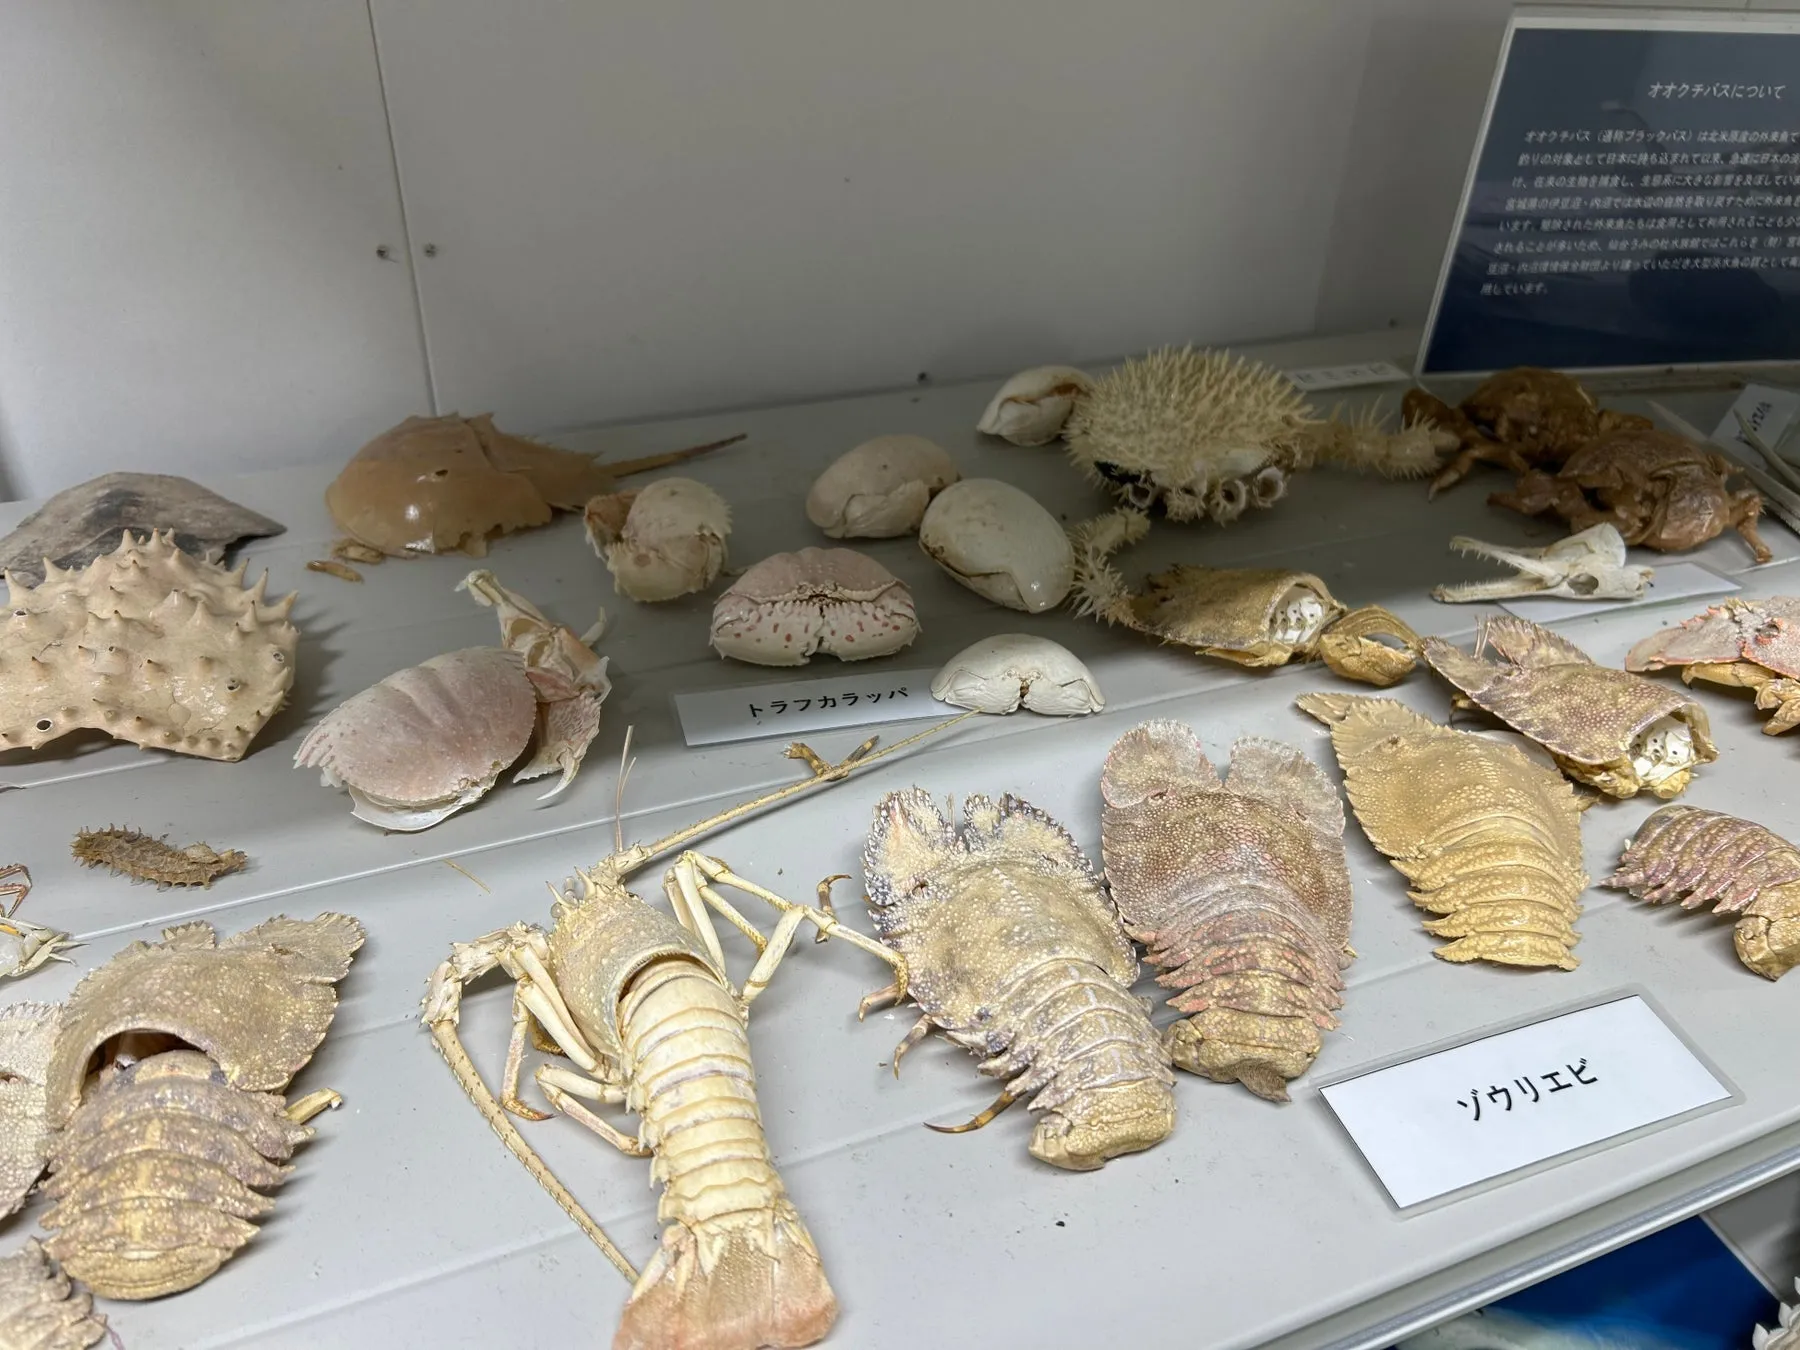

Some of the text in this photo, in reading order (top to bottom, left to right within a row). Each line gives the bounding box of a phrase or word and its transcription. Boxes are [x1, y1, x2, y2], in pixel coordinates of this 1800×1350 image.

[1648, 81, 1786, 99] オオクチバスについて
[750, 687, 909, 718] トラフカラッパ
[1457, 1058, 1598, 1121] ゾウリエビ
